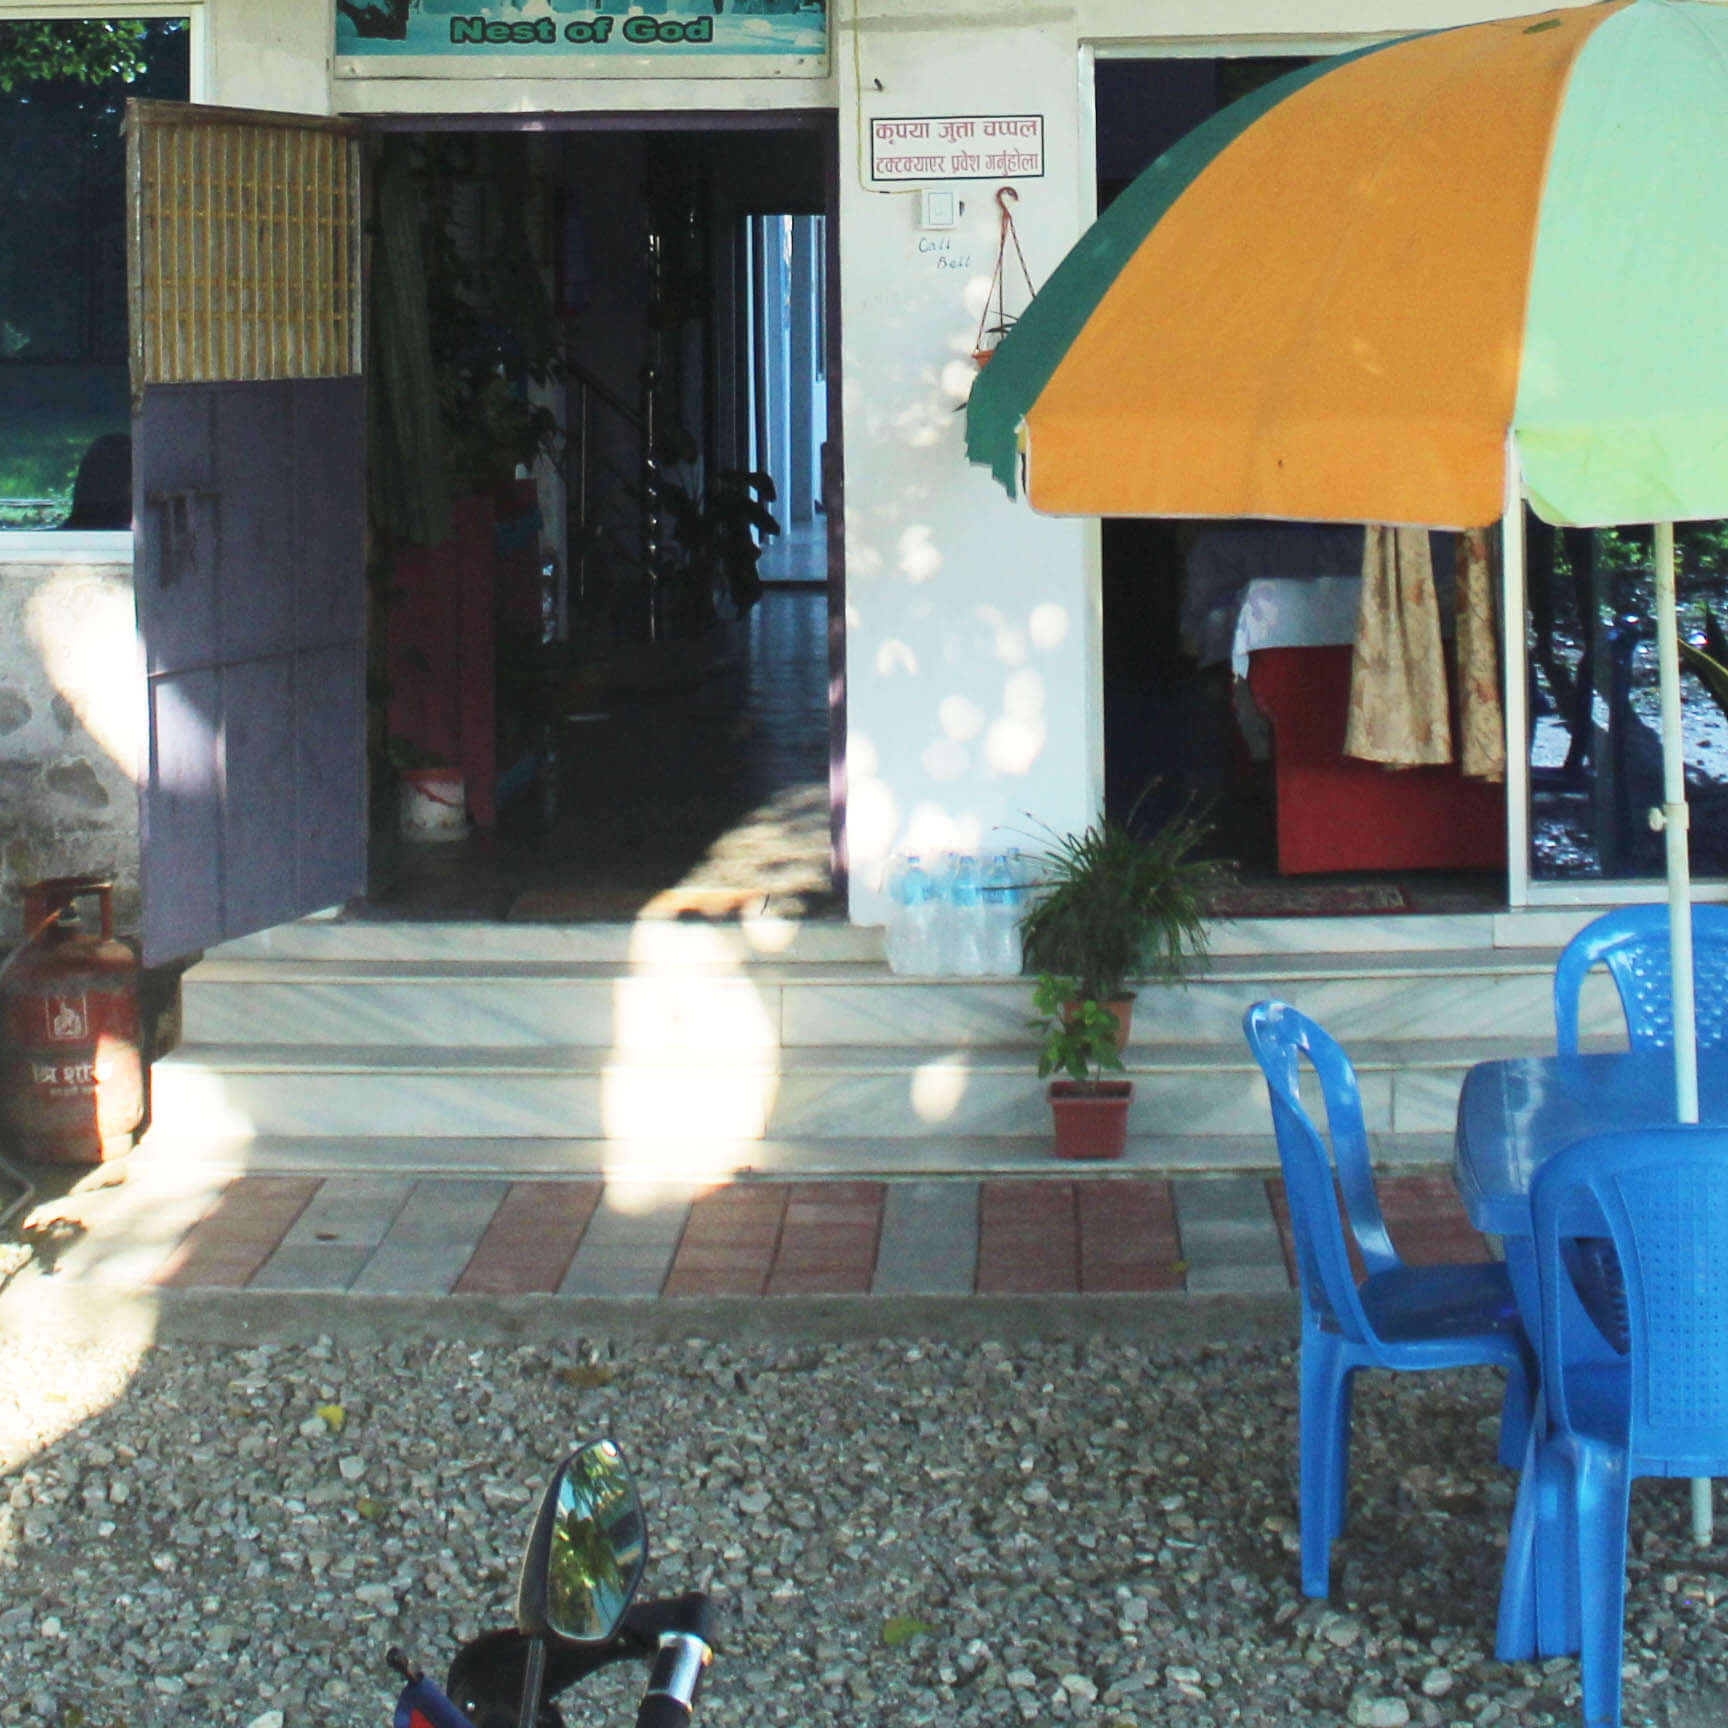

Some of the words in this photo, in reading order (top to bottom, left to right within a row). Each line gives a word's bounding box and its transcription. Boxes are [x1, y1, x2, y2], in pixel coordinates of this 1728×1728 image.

[450, 15, 557, 45] Nest
[564, 15, 614, 45] of
[622, 15, 714, 44] God
[875, 122, 930, 145] कृपया
[984, 119, 1037, 138] चप्पल
[951, 150, 980, 173] प्रवेश
[918, 238, 951, 253] Call
